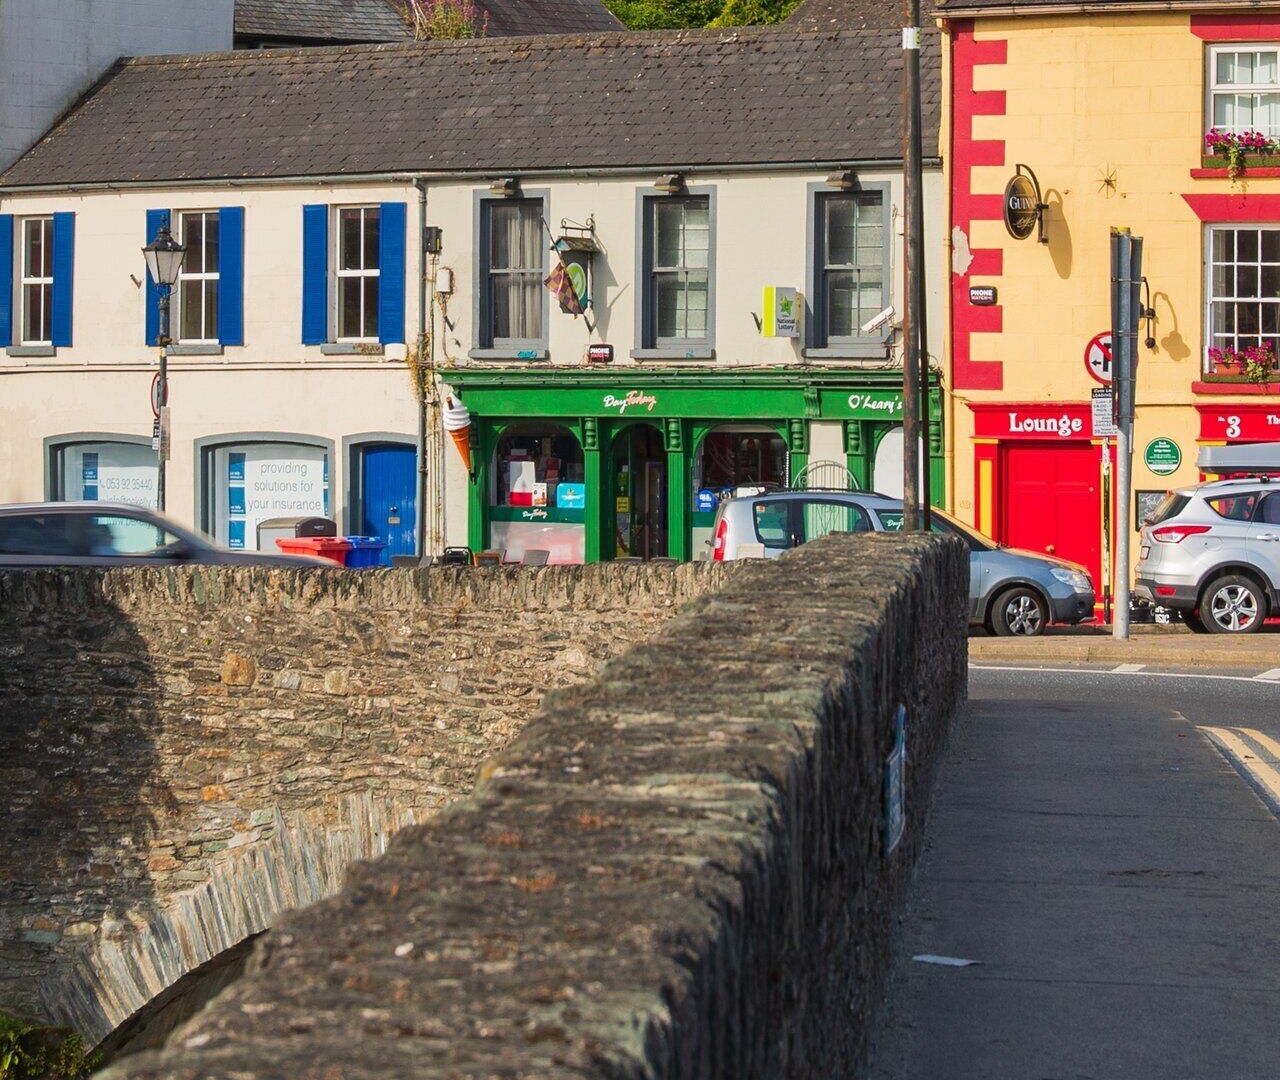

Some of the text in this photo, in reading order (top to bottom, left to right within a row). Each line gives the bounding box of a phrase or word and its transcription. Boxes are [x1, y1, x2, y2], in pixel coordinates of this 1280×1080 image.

[848, 394, 903, 413] O'Leary's
[1009, 412, 1083, 437] Lounge
[1226, 415, 1241, 438] 3
[260, 461, 308, 477] providing
[254, 479, 314, 492] solutions for
[248, 500, 270, 512] your
[272, 499, 322, 511] insurance
